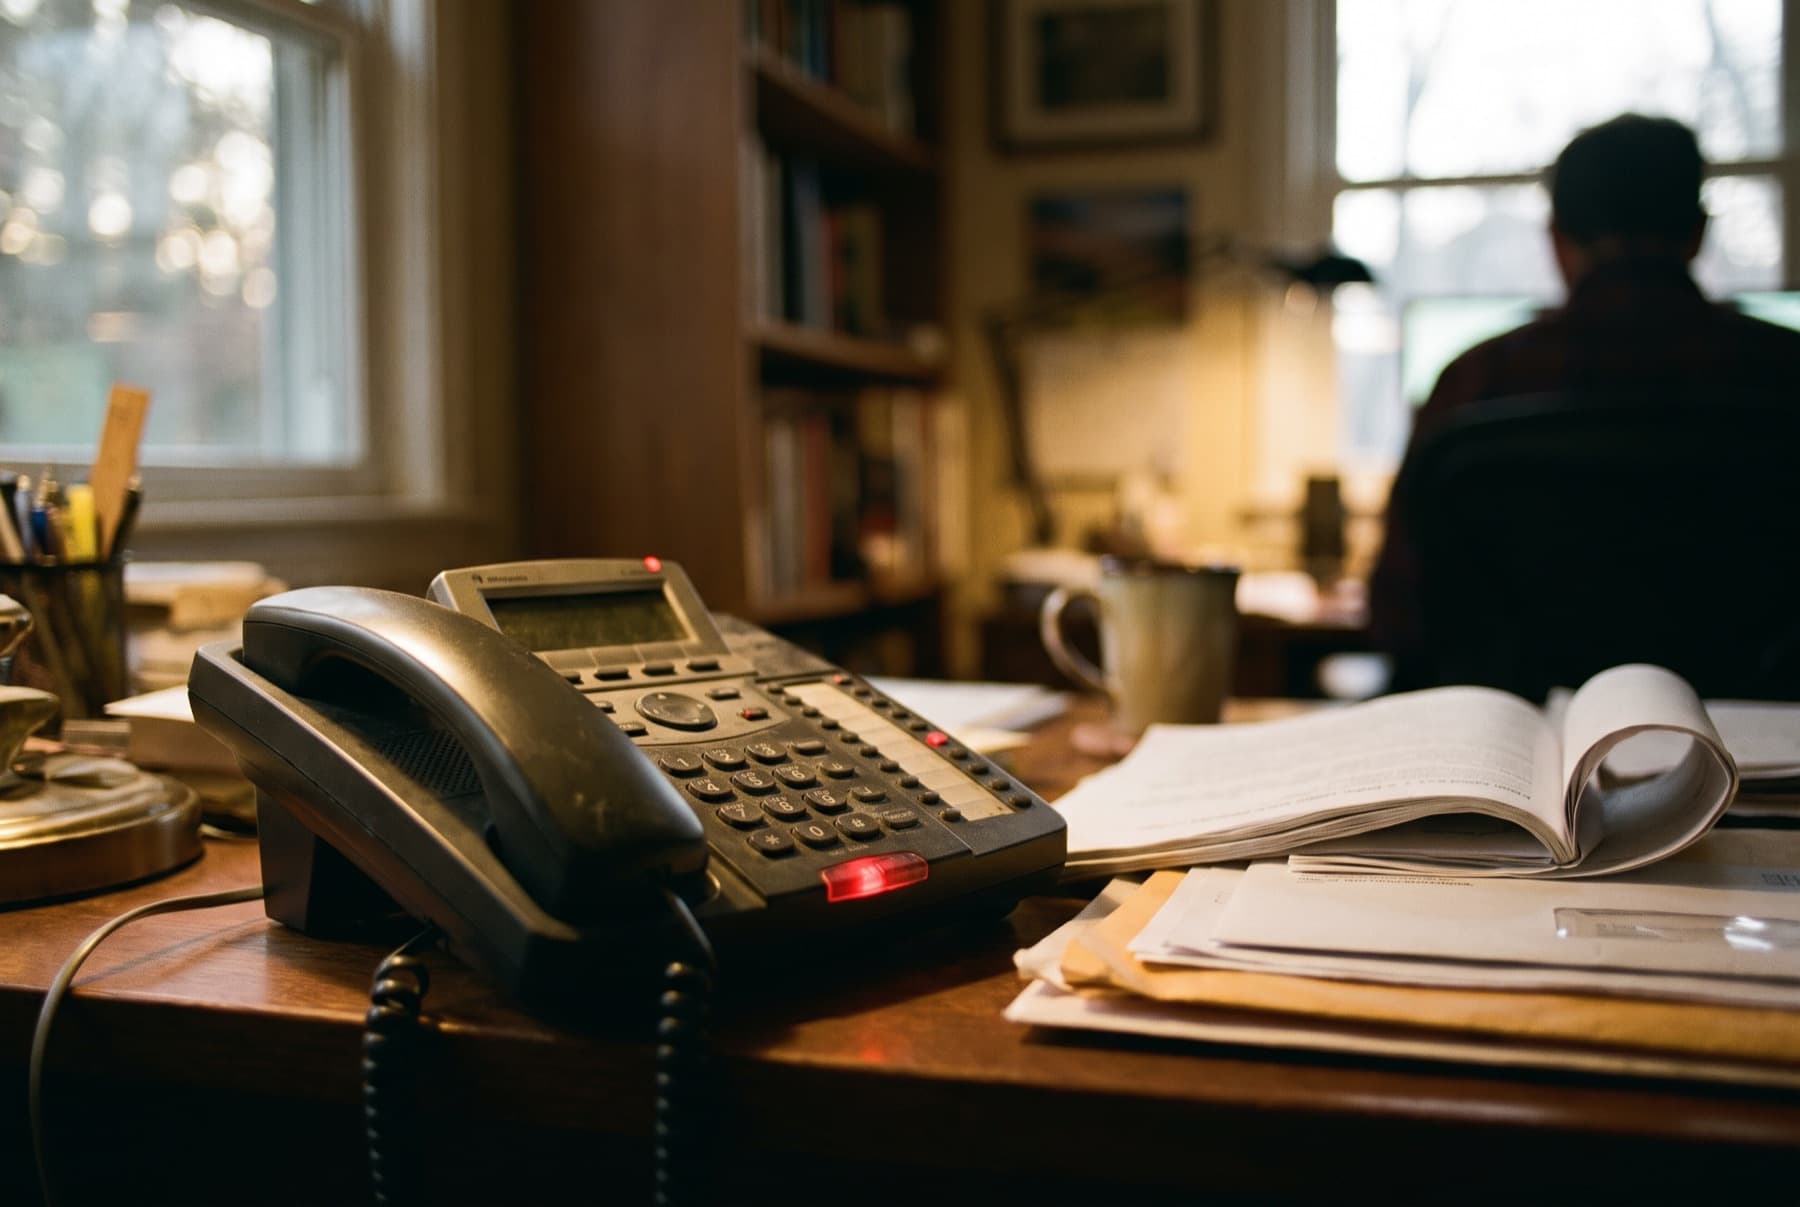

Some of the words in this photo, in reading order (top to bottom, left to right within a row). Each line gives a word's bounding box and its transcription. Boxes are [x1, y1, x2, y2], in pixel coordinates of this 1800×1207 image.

[720, 753, 734, 761] 2
[677, 758, 689, 767] 1
[791, 769, 805, 779] 6
[748, 776, 763, 785] 5
[707, 783, 720, 791] 4
[822, 794, 836, 804] 9
[779, 801, 793, 811] 8
[736, 807, 746, 818] 7
[851, 818, 865, 828] #
[809, 826, 824, 837] 0
